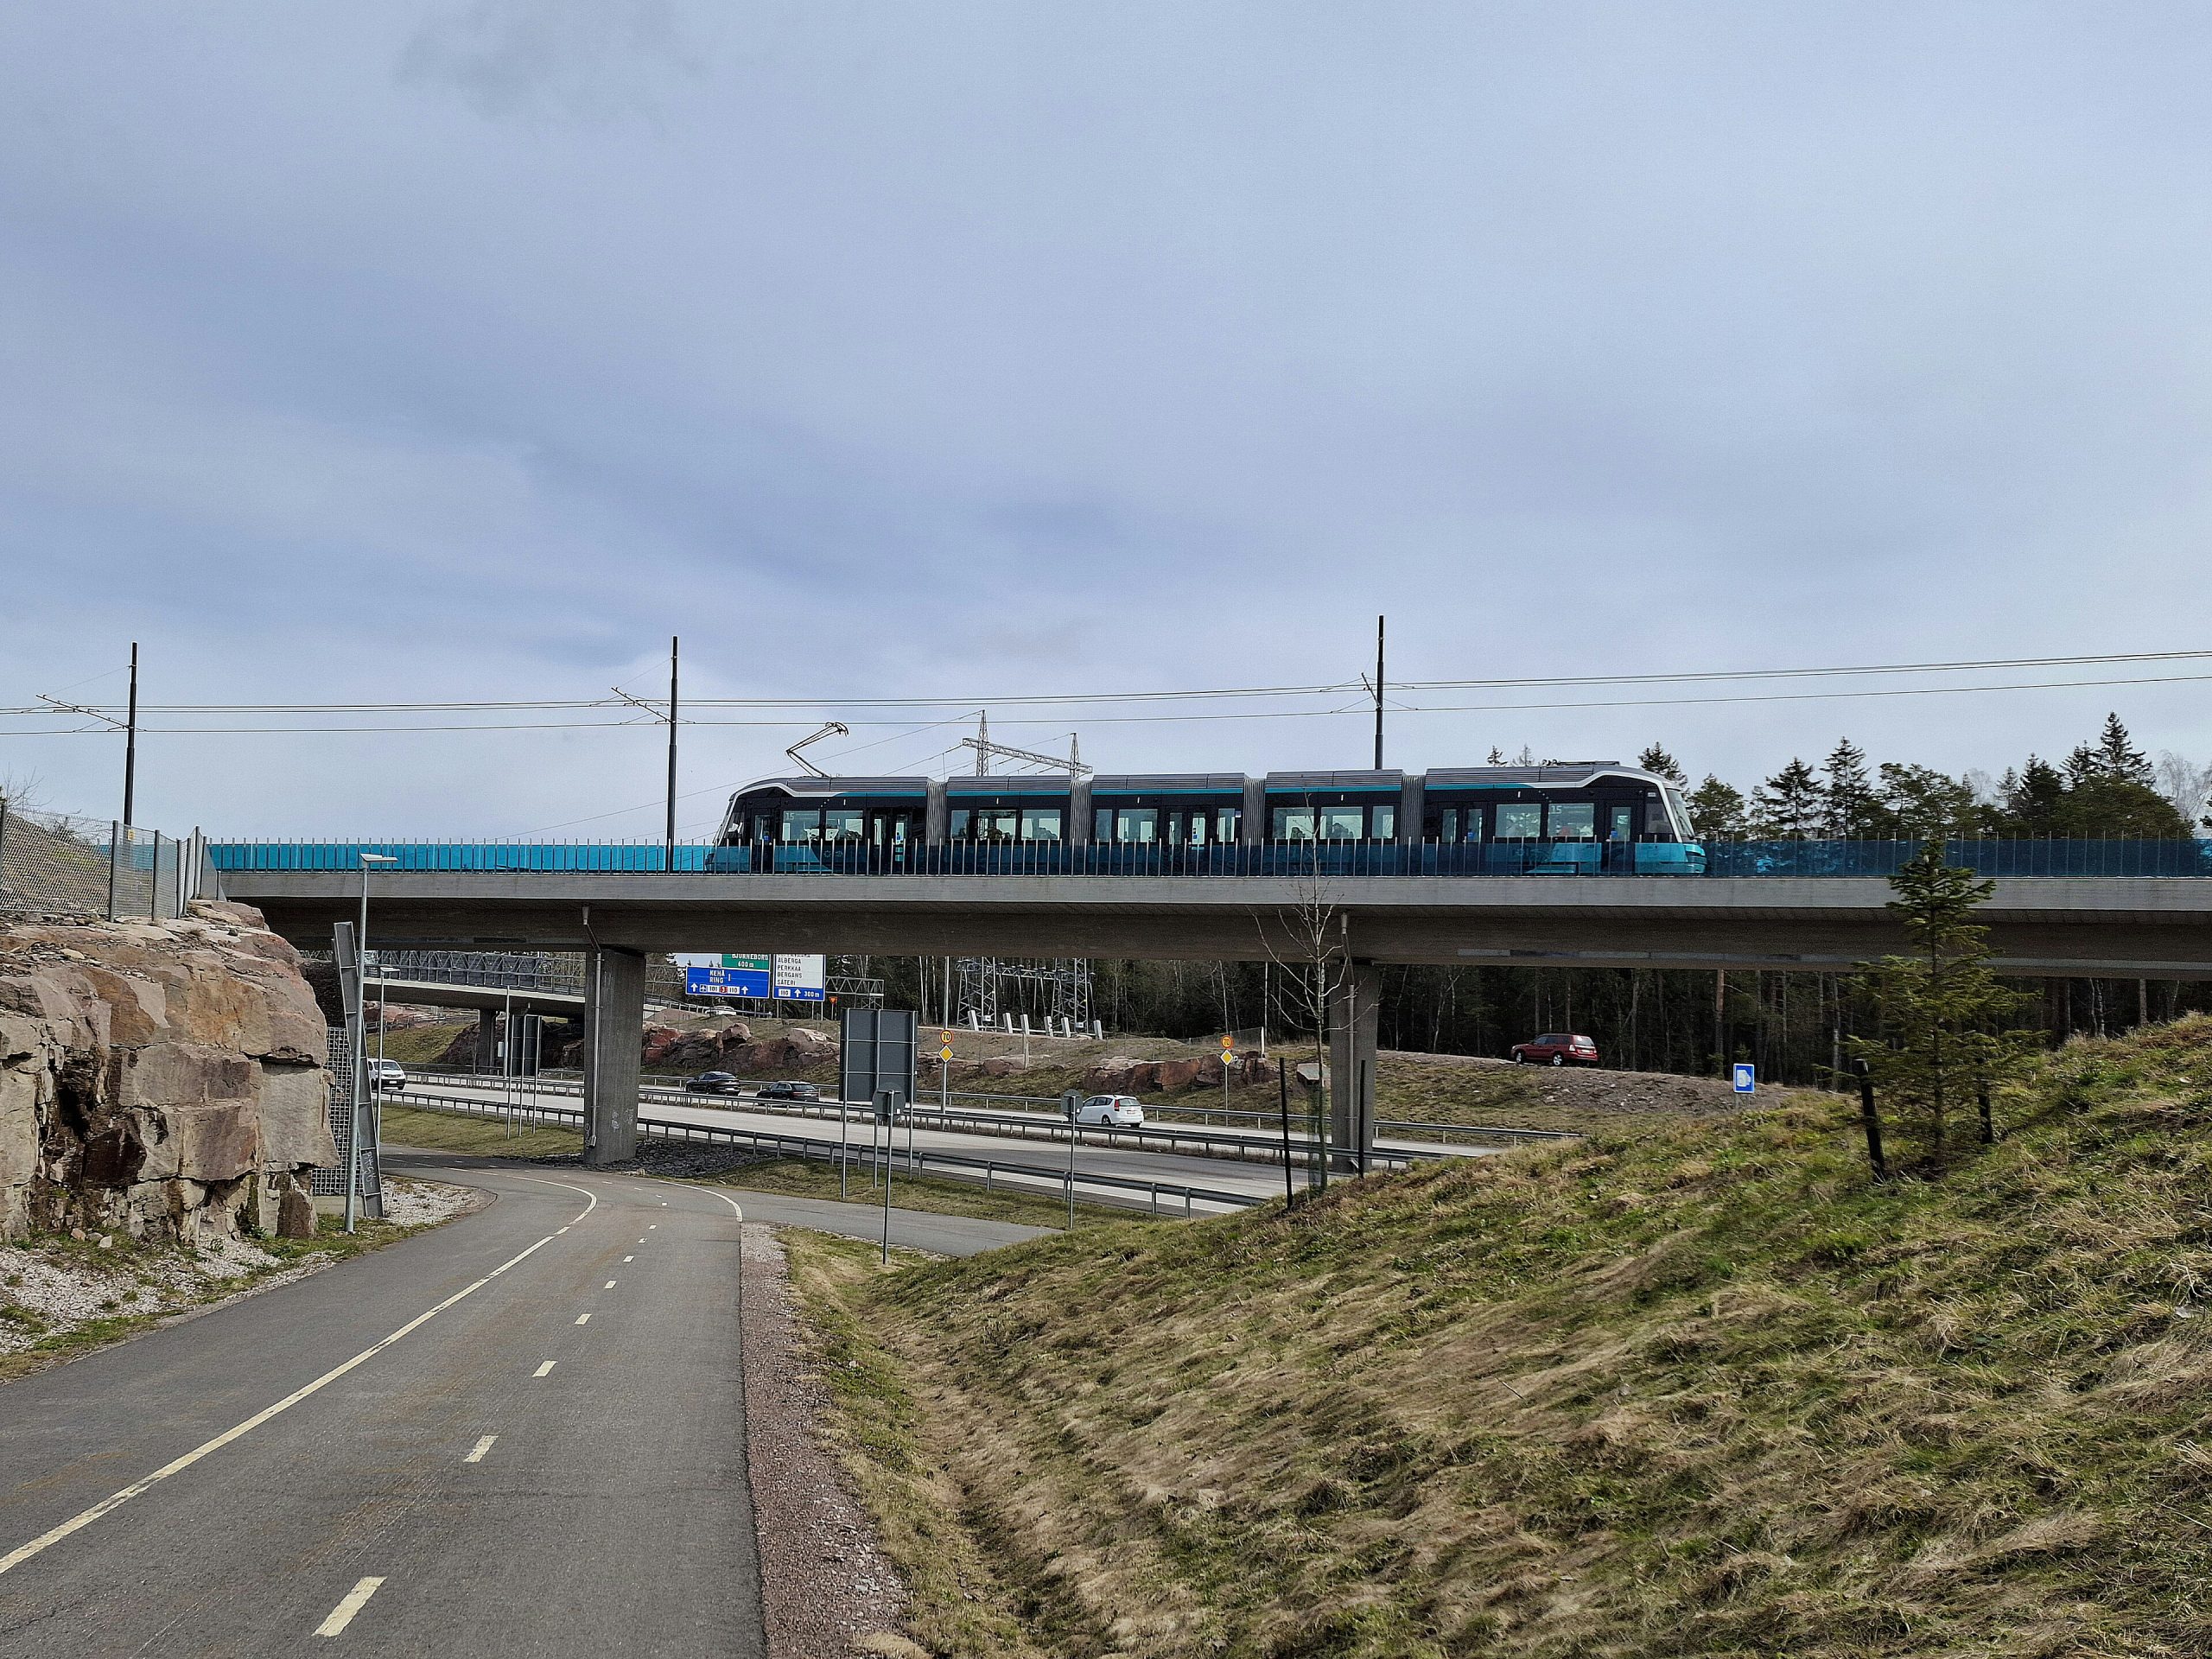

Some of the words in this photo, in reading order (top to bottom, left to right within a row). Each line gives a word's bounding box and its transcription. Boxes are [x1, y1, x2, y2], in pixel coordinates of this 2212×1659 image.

[1551, 805, 1562, 814] 15
[785, 812, 795, 821] 15
[943, 1033, 950, 1041] 70
